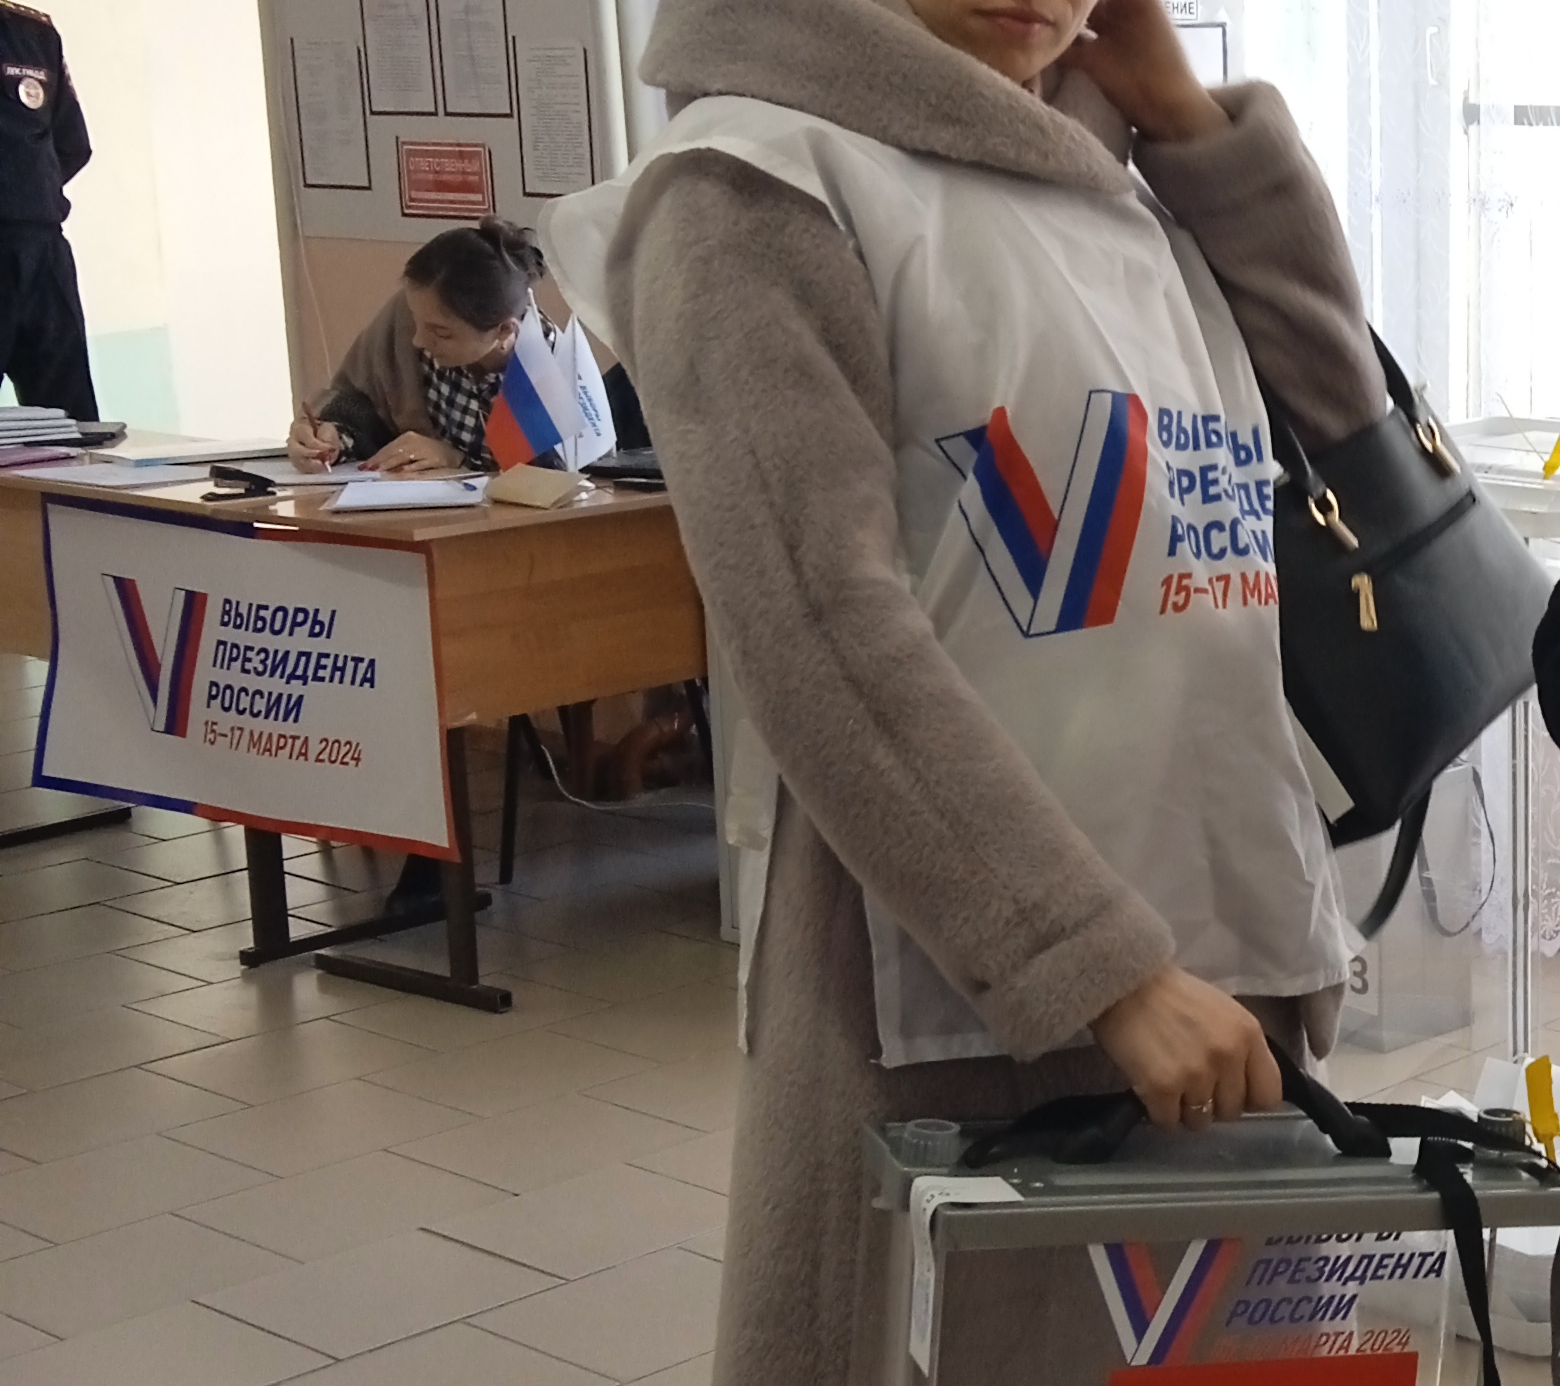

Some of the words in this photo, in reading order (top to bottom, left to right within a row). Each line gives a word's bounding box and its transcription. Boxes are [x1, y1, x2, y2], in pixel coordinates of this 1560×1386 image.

[1240, 570, 1279, 608] МА
[219, 598, 337, 639] ВЫБОРЫ
[212, 639, 377, 689] ПРЕЗИДЕНТА
[206, 680, 304, 723] РОССИИ
[247, 729, 309, 762] МАРТА
[314, 737, 363, 768] 2024
[1350, 955, 1369, 995] 3
[1246, 1251, 1447, 1287] ПРЕЗИДЕНТА
[1225, 1293, 1359, 1328] РОССИИ
[1356, 1328, 1411, 1354] 2024
